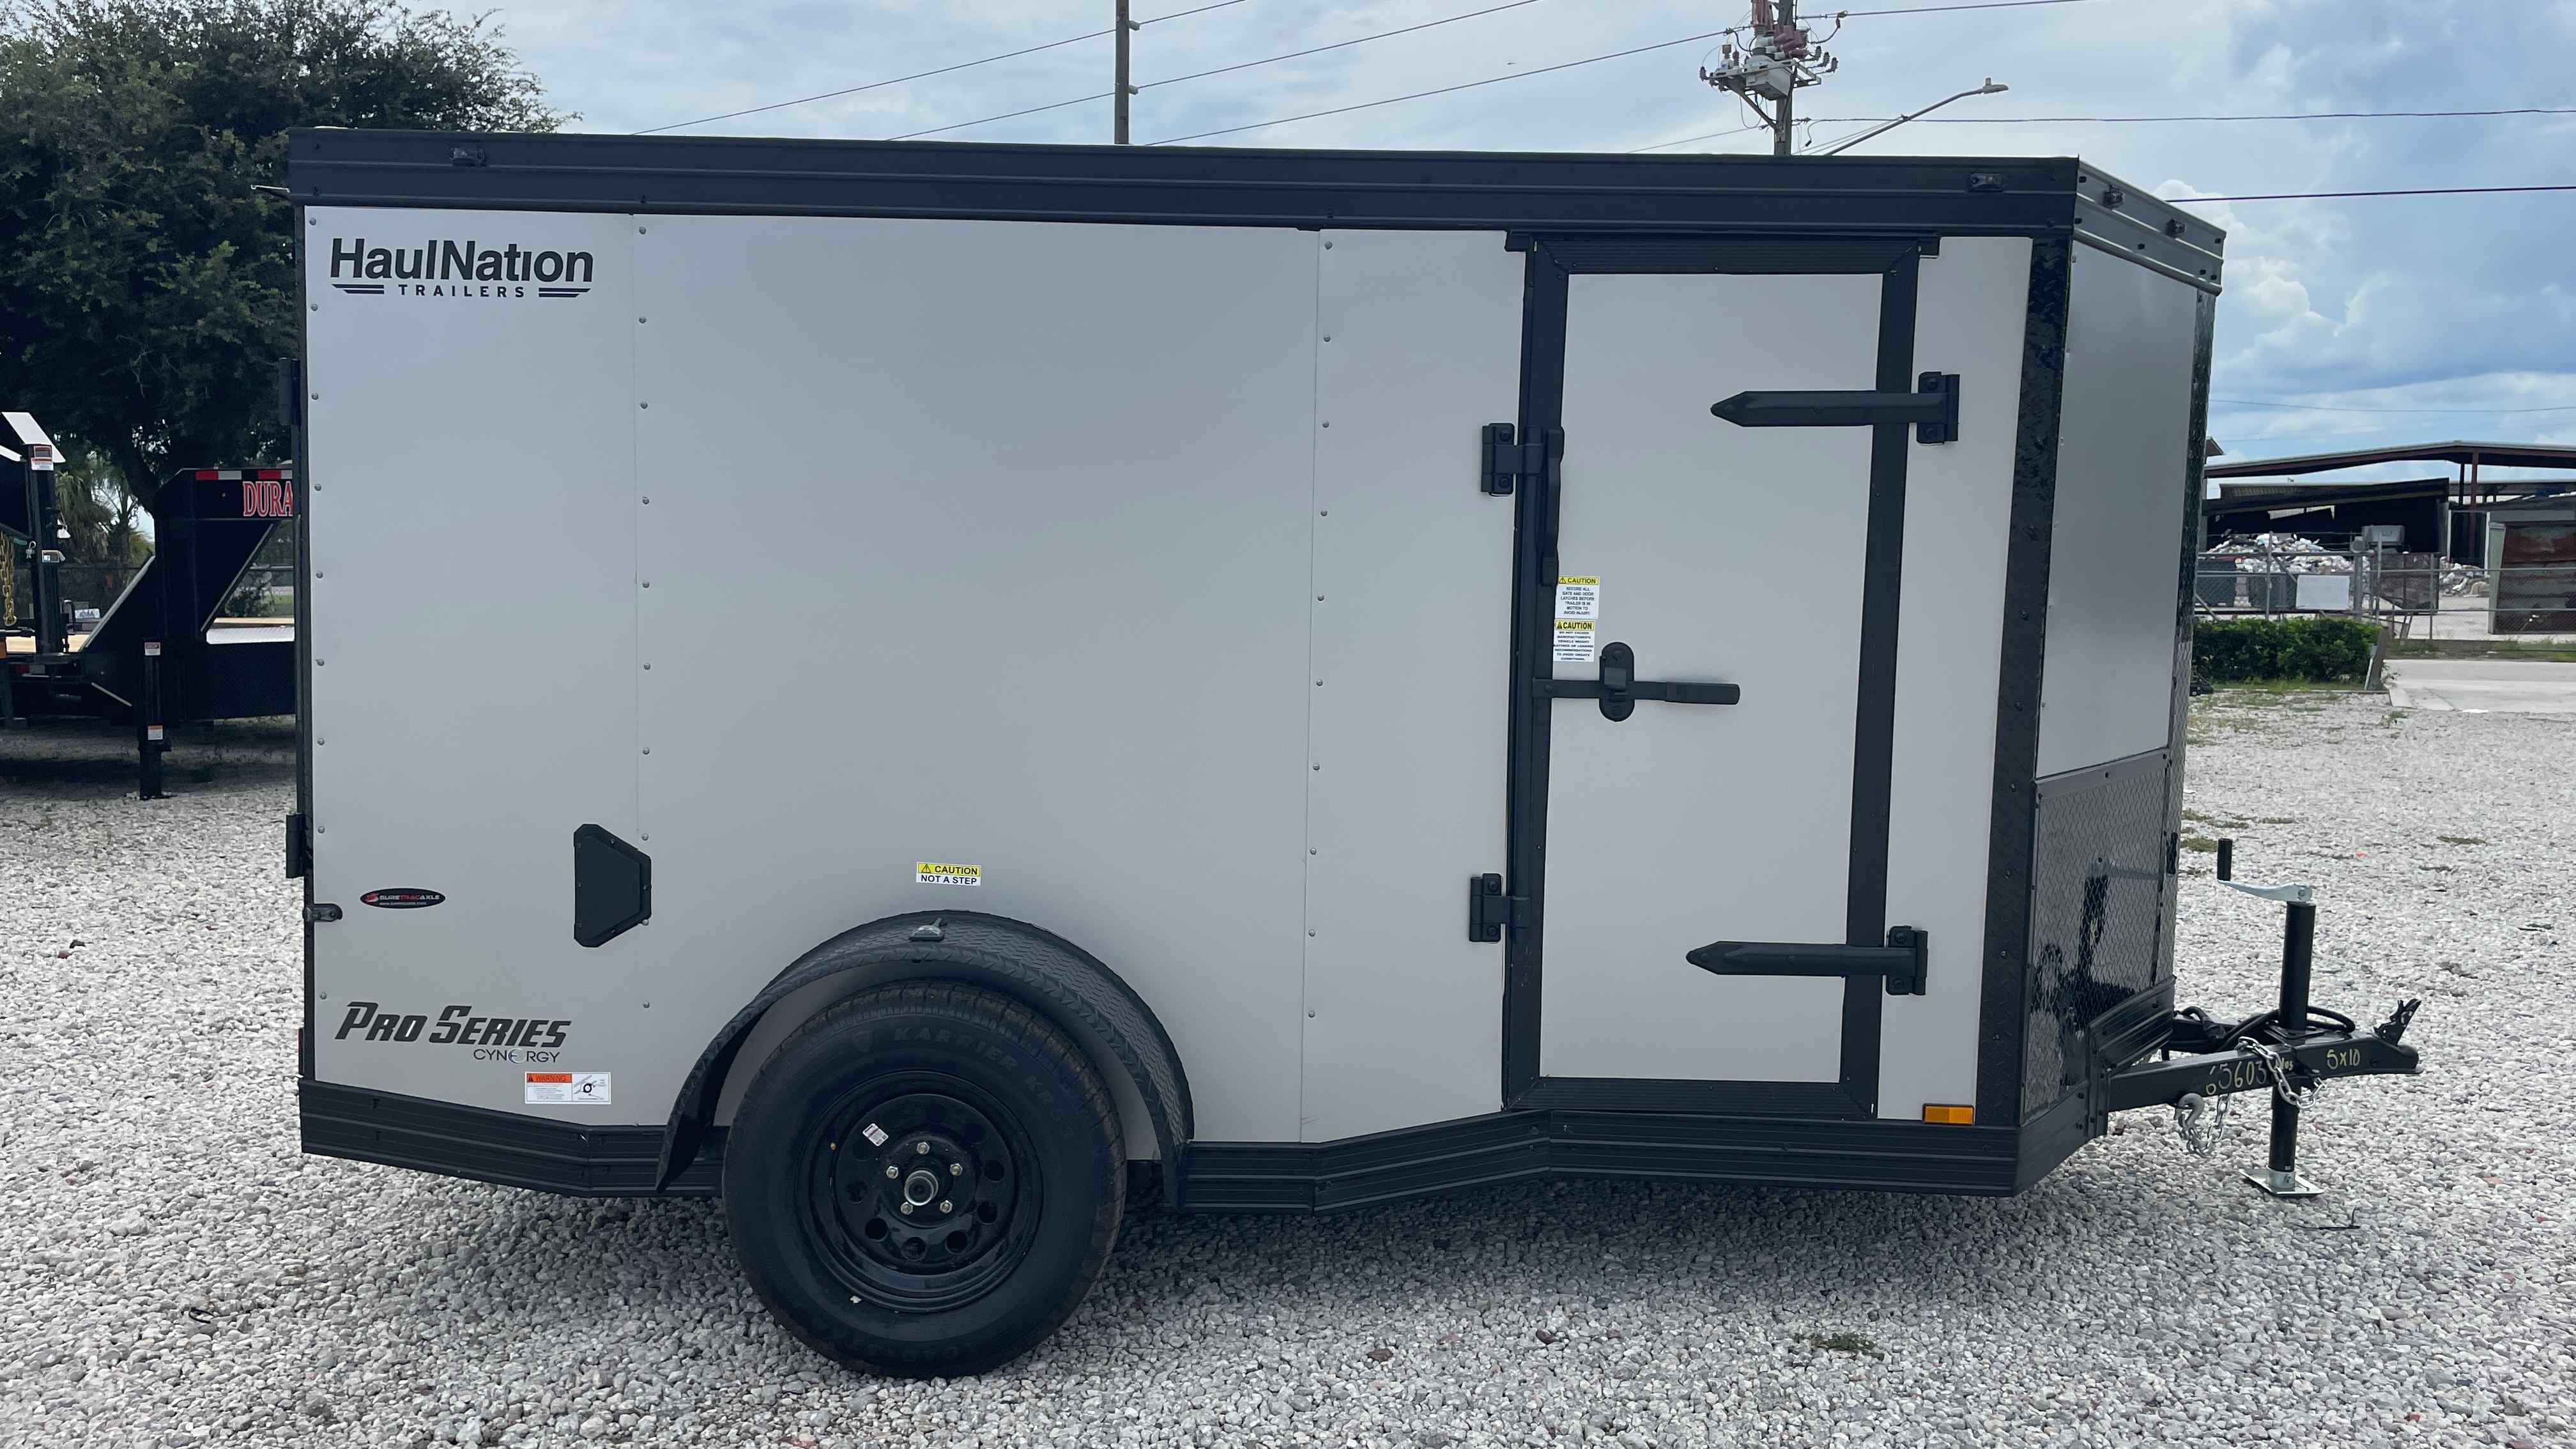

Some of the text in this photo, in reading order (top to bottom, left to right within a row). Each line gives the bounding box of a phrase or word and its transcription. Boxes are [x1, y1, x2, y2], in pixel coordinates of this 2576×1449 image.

[330, 238, 594, 282] HaulNation
[398, 284, 525, 298] TRAILERS
[243, 481, 293, 517] DURA
[935, 865, 977, 875] CAUTION
[953, 876, 977, 885] STEP
[473, 1047, 560, 1064] CYNERGY
